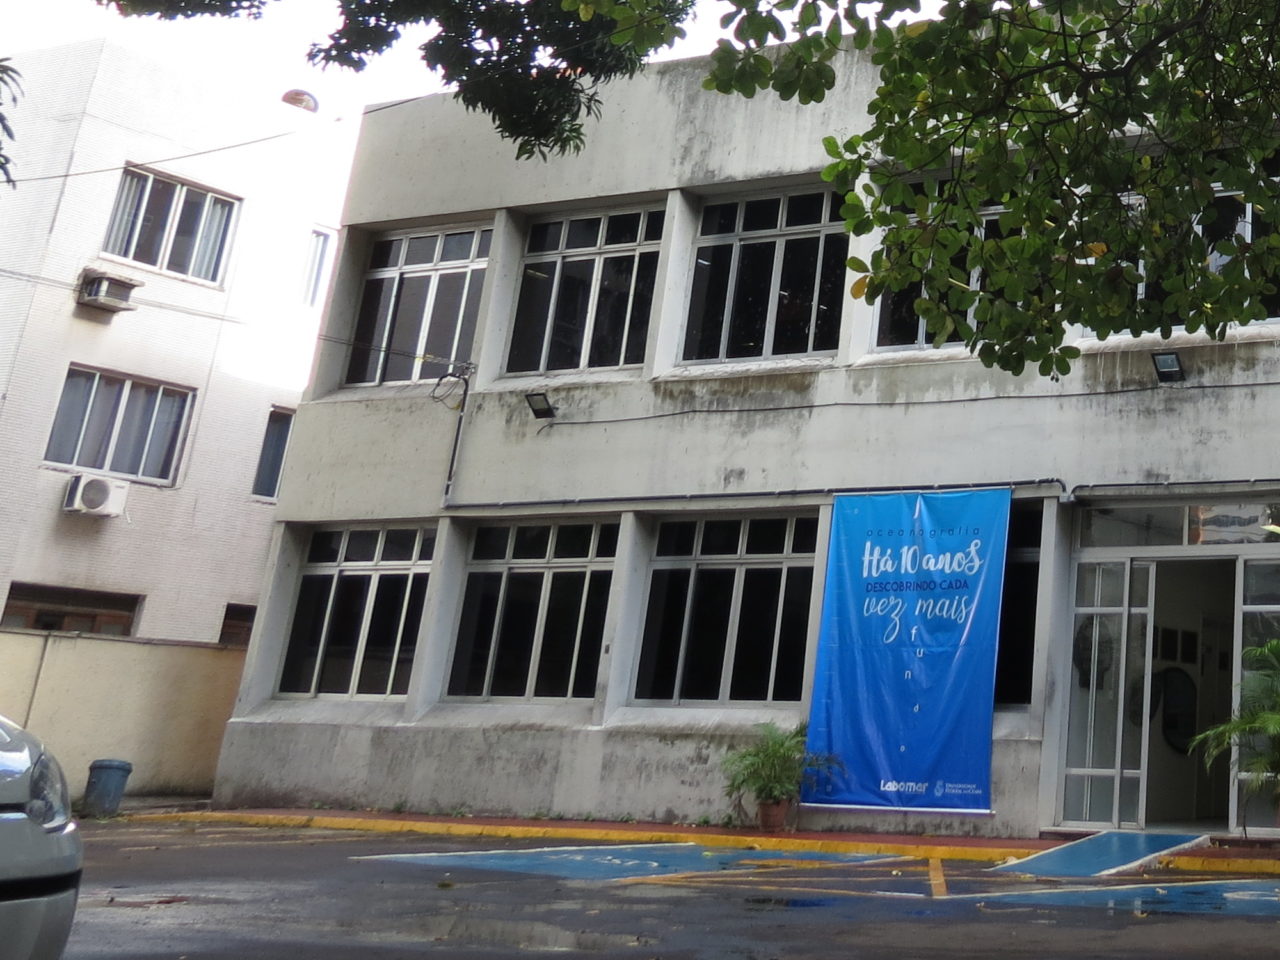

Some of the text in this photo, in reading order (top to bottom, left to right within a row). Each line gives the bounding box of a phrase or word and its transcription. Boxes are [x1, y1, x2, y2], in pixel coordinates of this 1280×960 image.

[862, 540, 898, 578] Há
[900, 545, 920, 574] 10
[866, 580, 969, 593] DESCOBRINDO CADA
[863, 596, 974, 643] vez mais
[880, 779, 928, 794] Labomar
